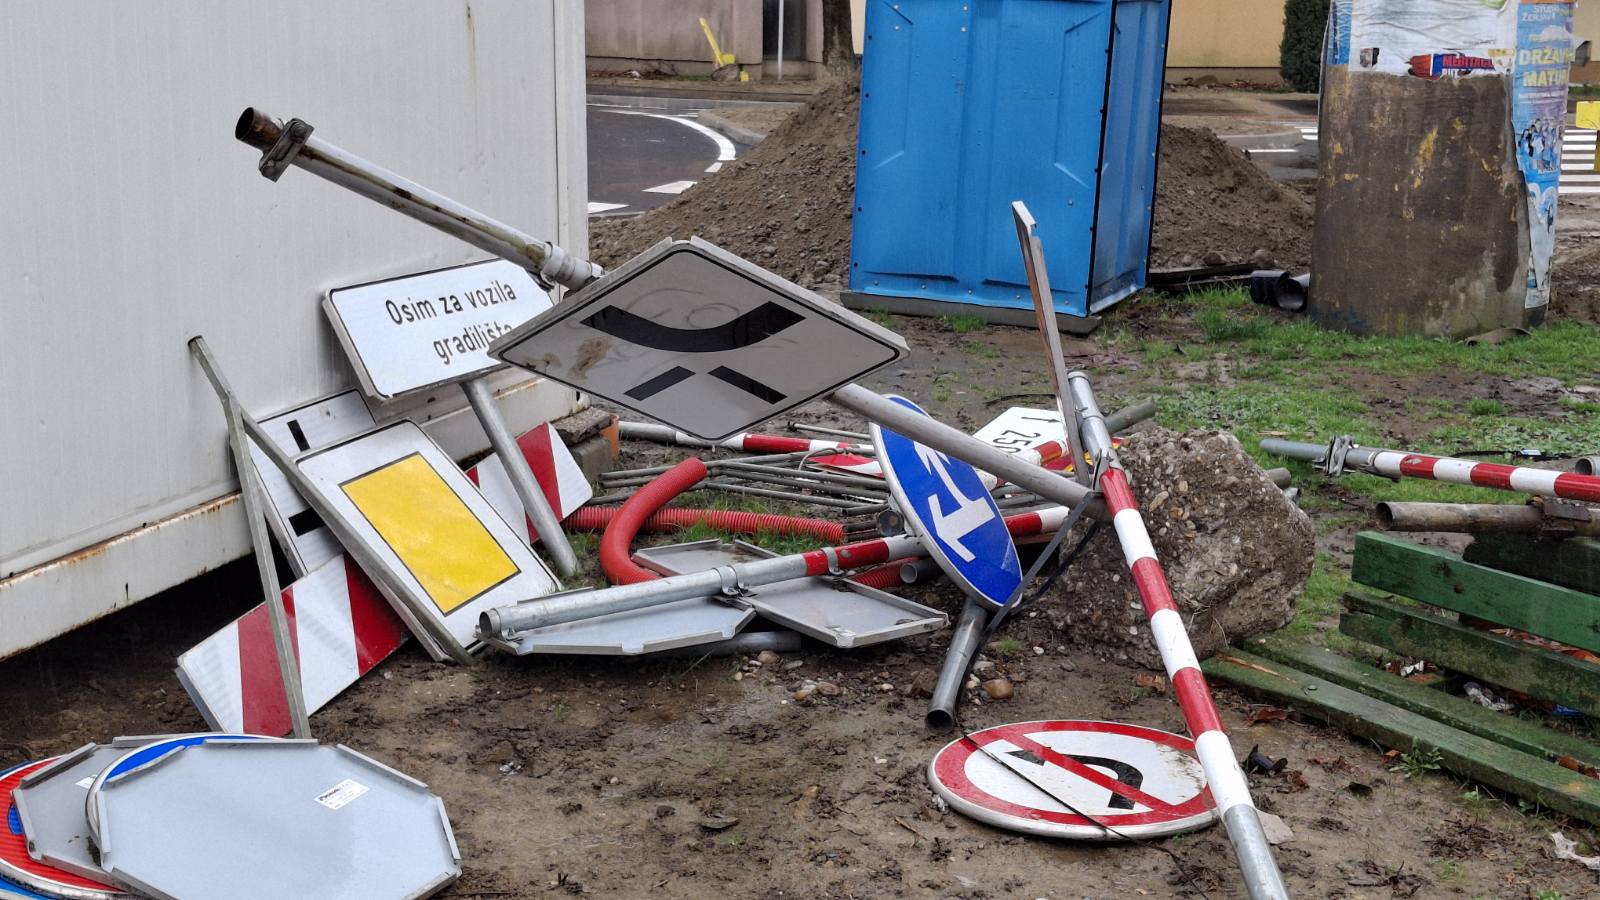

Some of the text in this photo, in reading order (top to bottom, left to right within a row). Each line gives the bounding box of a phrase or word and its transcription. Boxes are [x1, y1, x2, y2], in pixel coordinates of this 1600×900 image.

[385, 280, 517, 325] Osim za vozila
